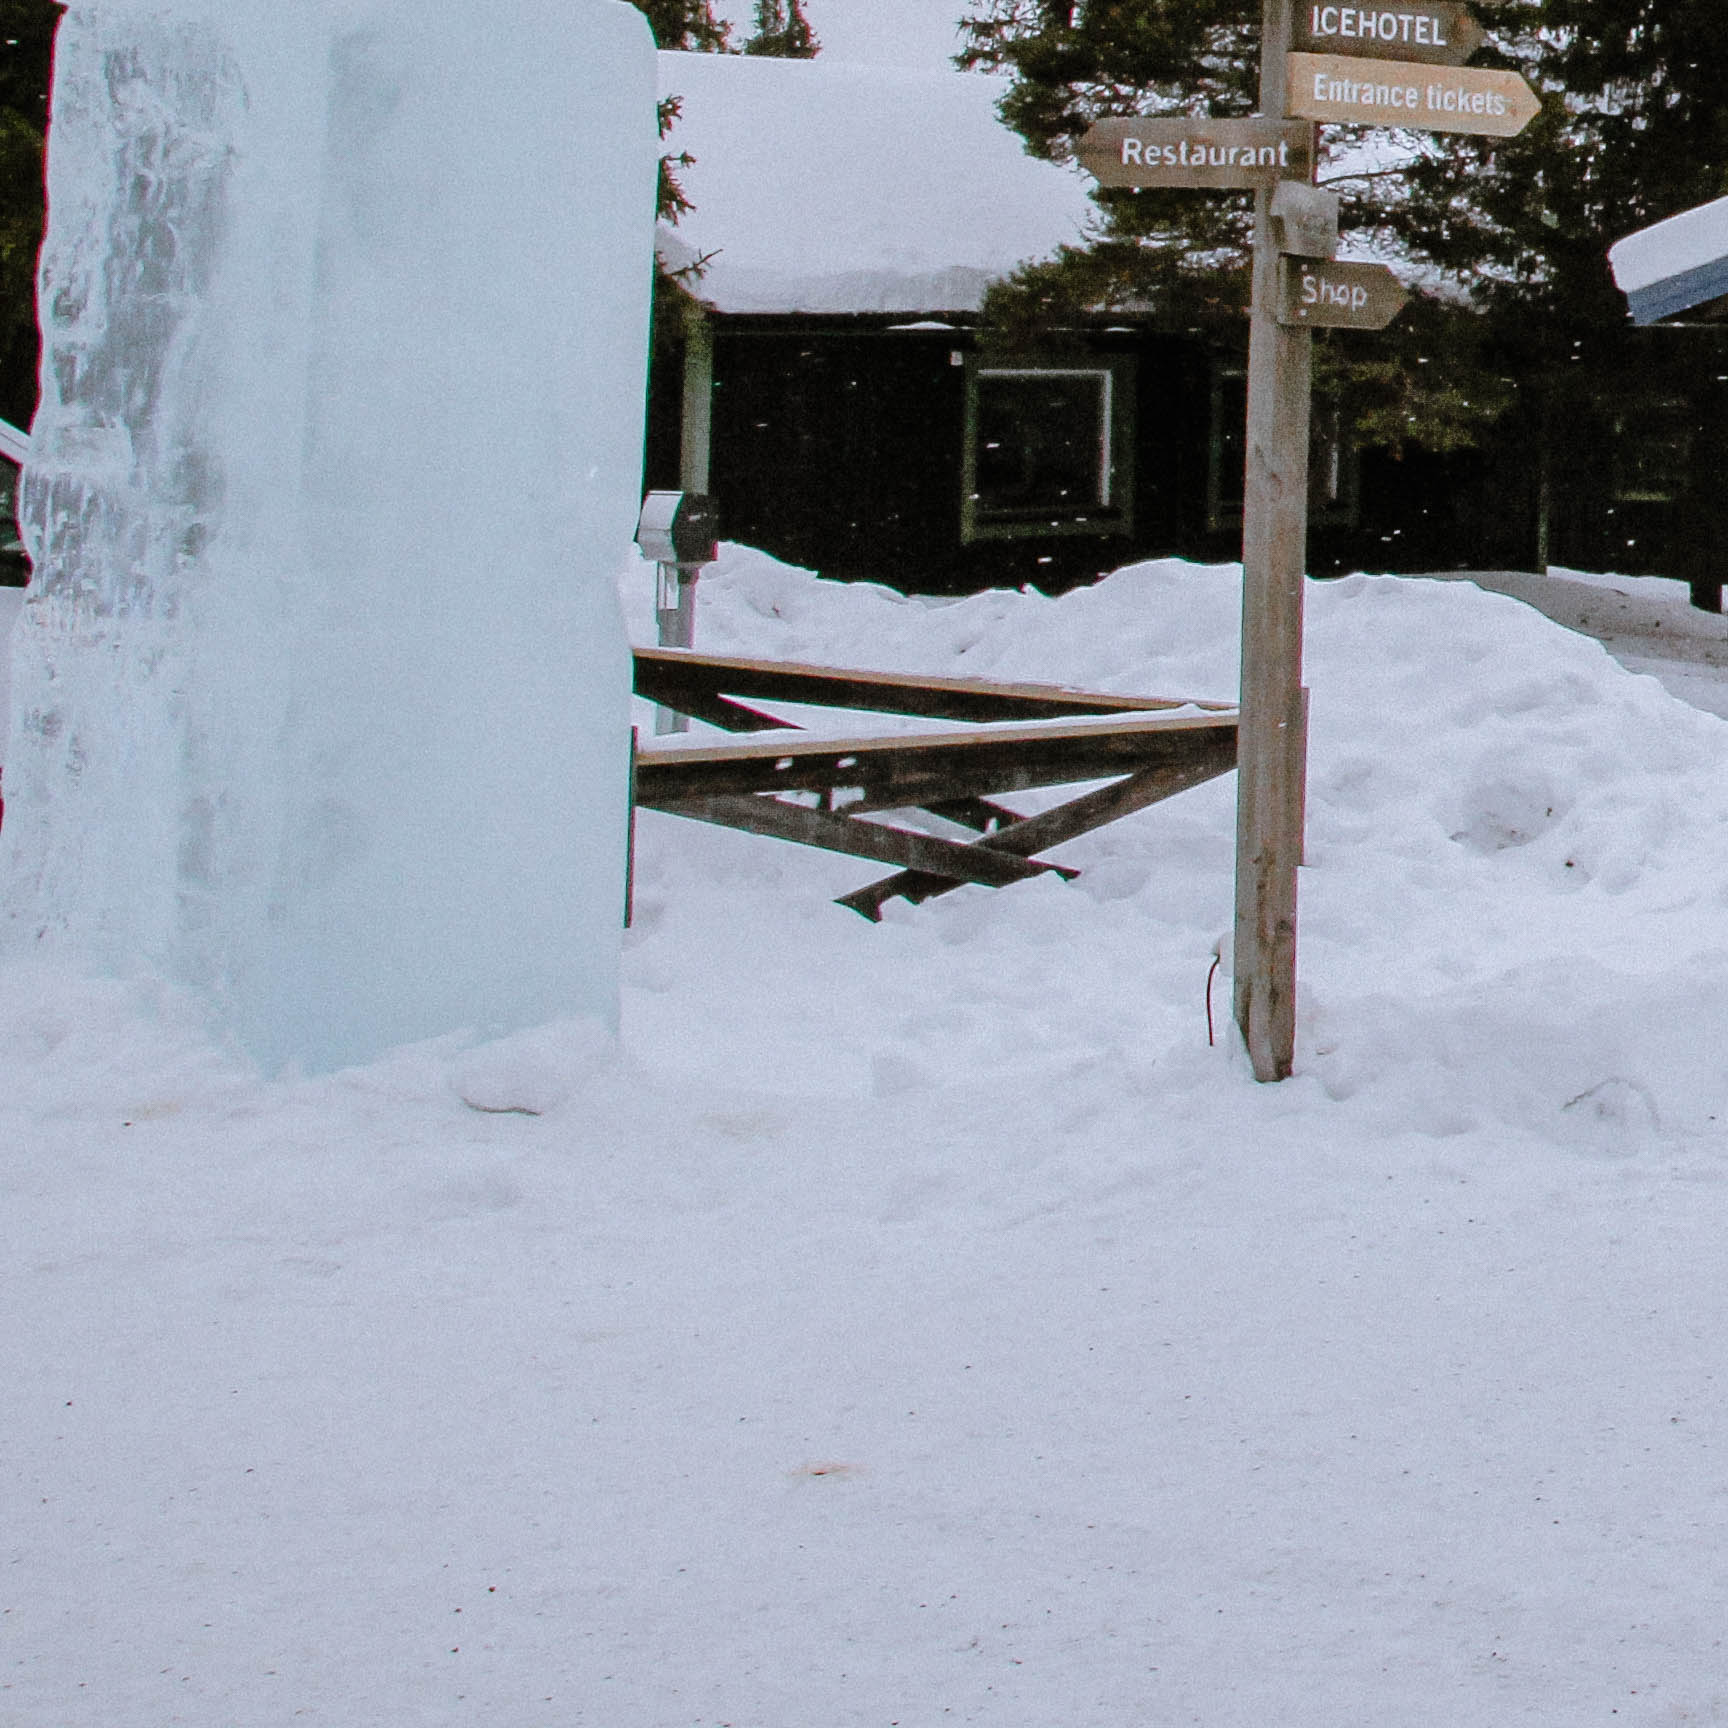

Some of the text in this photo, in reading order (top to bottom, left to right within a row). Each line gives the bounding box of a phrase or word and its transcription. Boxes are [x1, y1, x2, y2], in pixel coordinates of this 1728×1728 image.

[1311, 5, 1448, 47] ICEHOTEL
[1313, 72, 1507, 116] Entrance tickets
[1121, 137, 1289, 168] Restaurant
[1302, 274, 1368, 312] Shop
